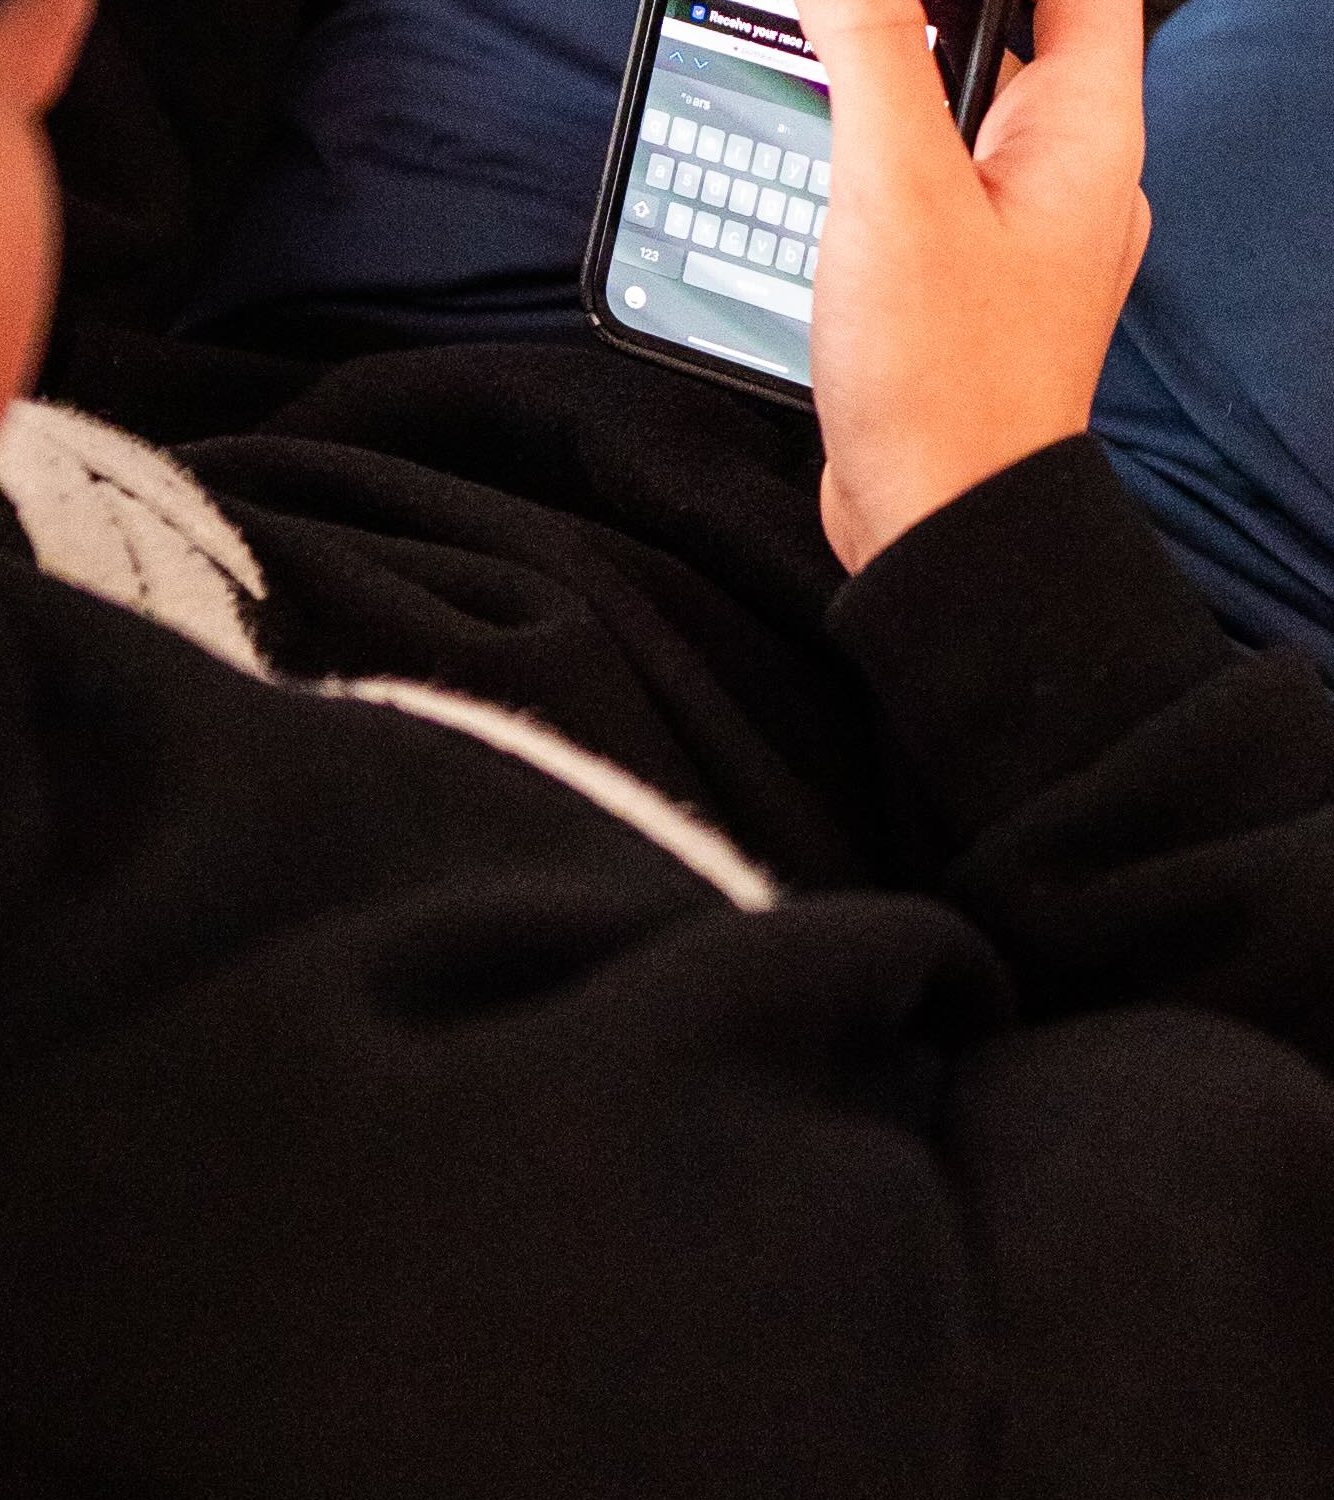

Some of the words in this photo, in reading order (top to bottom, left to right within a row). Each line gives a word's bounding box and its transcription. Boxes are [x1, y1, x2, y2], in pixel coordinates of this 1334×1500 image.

[709, 9, 753, 34] Receive
[752, 24, 779, 41] your
[778, 31, 804, 49] race
[639, 246, 660, 263] 123
